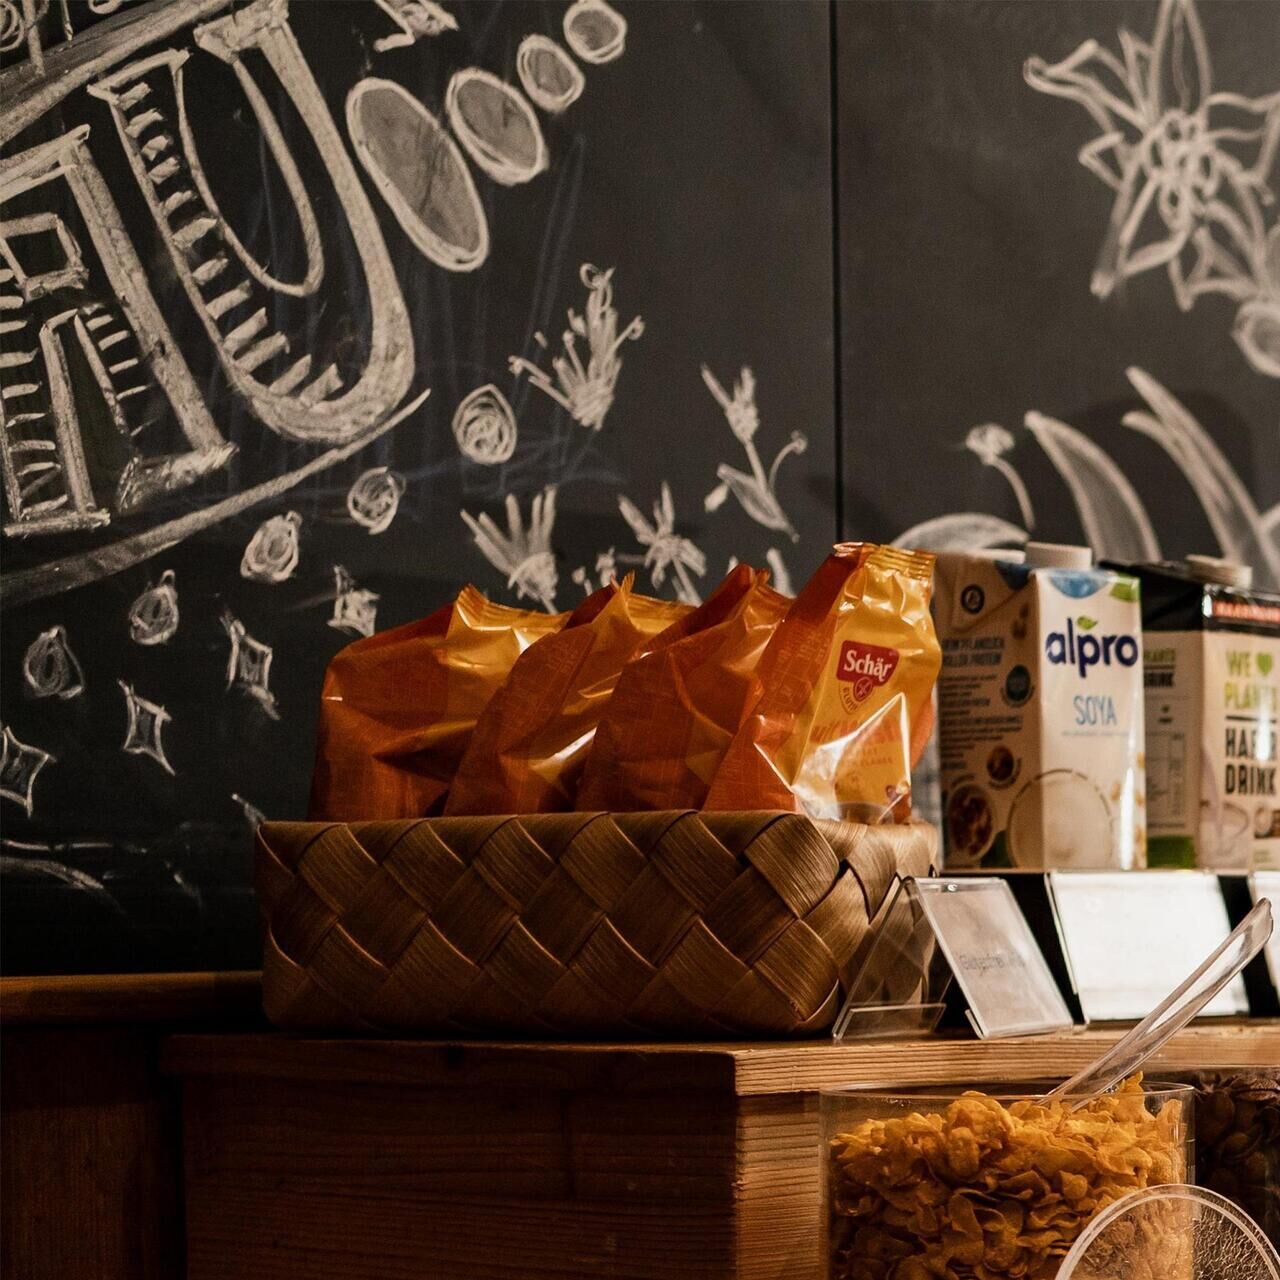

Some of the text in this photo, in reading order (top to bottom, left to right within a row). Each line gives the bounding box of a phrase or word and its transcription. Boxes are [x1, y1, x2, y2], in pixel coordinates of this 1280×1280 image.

[1045, 616, 1139, 679] alpro
[843, 649, 893, 683] Schär
[1225, 651, 1252, 678] WE
[1073, 694, 1118, 727] SOYA
[1225, 728, 1278, 761] HAFR
[1225, 763, 1278, 796] DRINK
